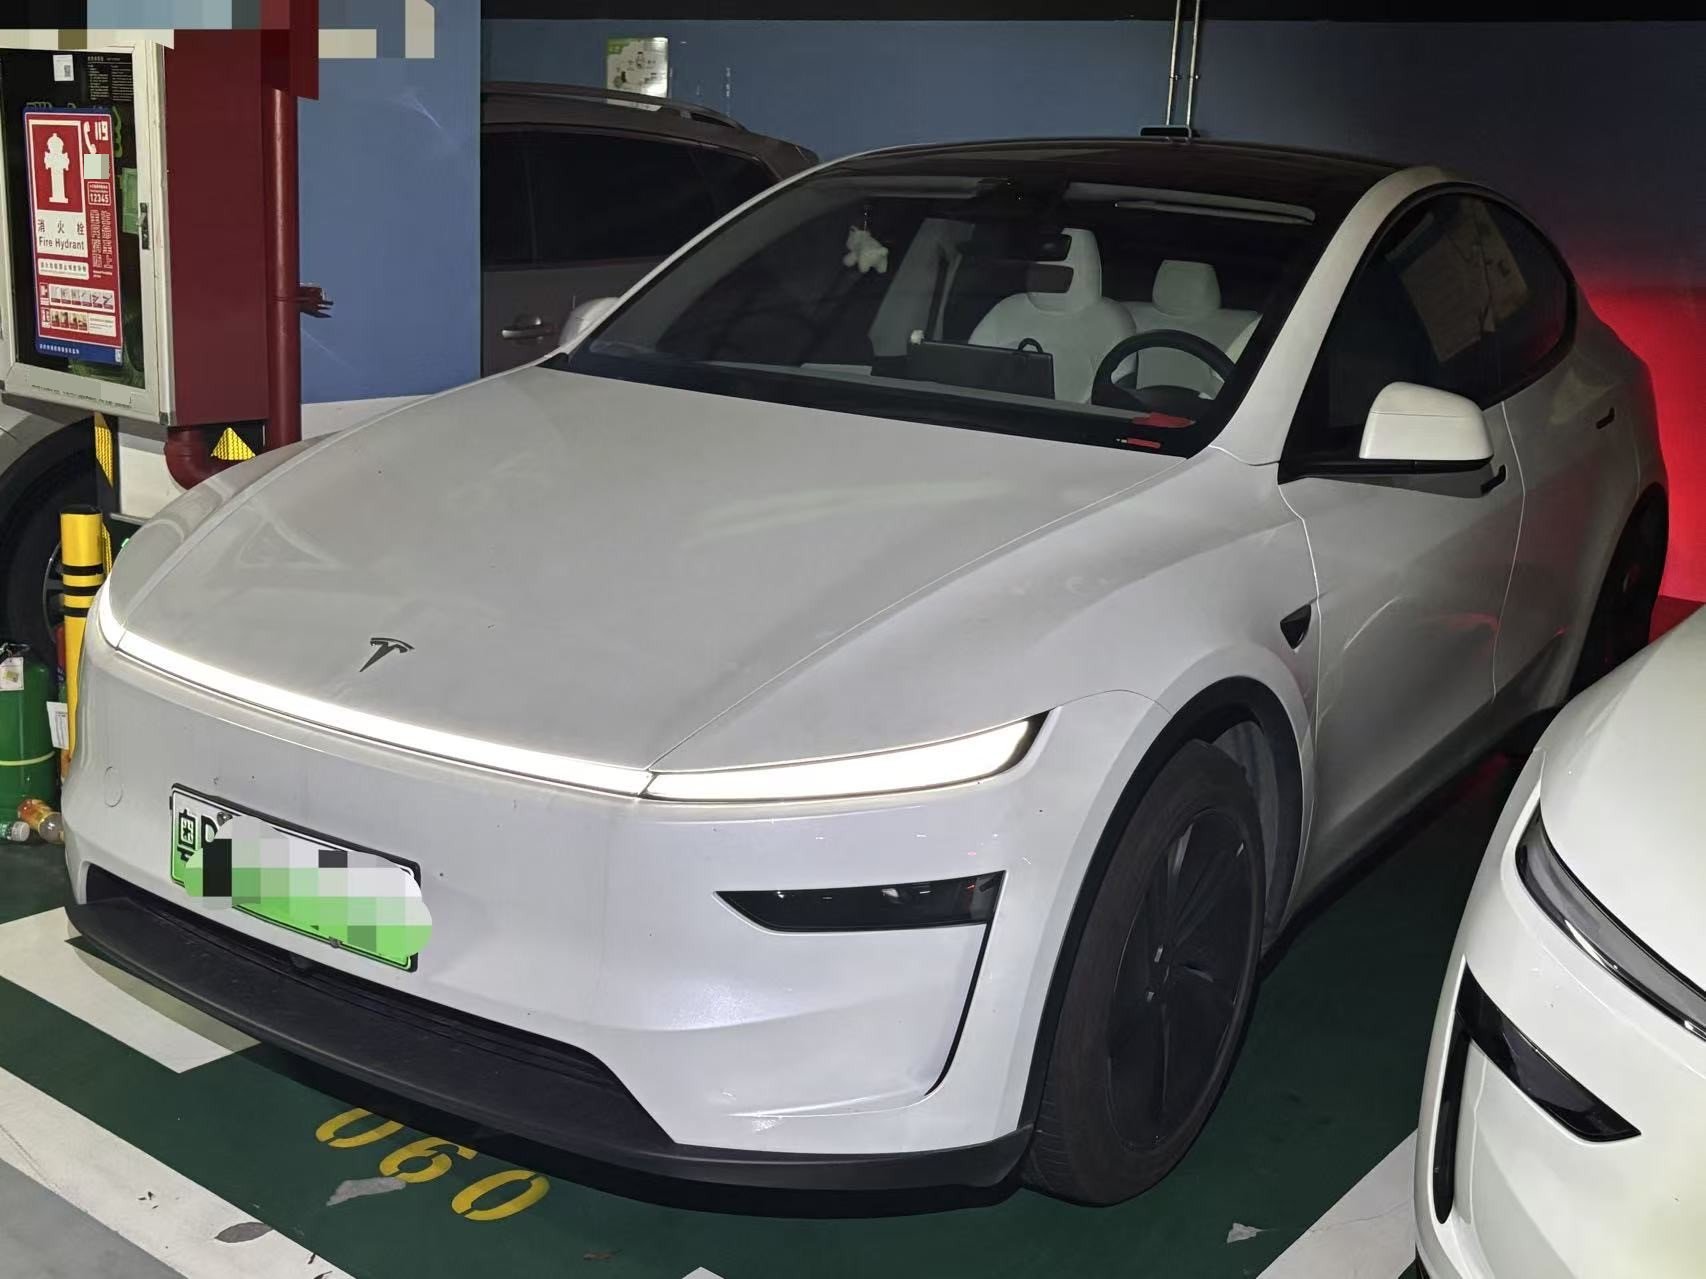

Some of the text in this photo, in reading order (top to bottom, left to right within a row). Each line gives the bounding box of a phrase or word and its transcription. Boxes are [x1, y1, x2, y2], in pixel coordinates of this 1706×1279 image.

[95, 121, 109, 141] 119
[90, 193, 109, 204] 12345
[37, 219, 85, 236] 消火栓
[39, 236, 85, 250] Fire Hydrant
[315, 1107, 550, 1221] 060
